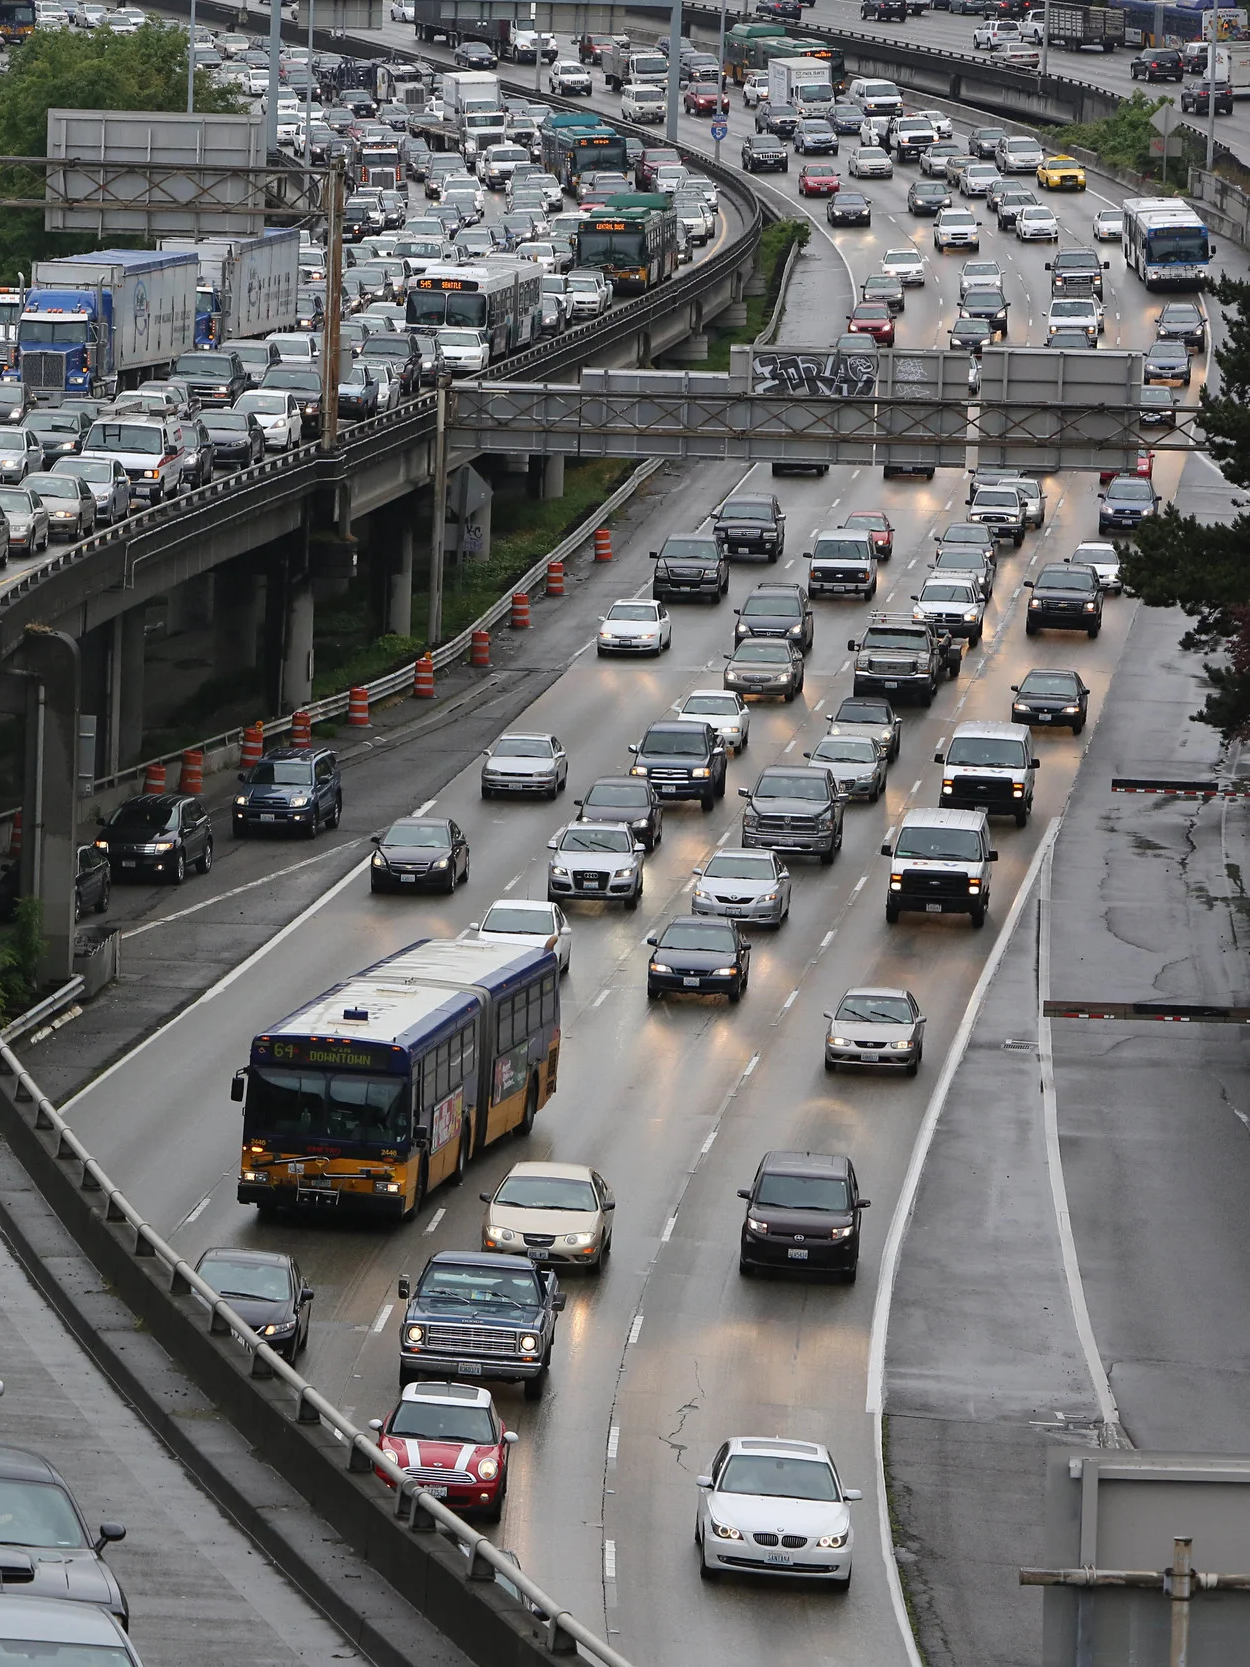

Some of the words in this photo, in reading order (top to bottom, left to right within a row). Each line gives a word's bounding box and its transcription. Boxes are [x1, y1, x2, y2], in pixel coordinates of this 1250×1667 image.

[715, 127, 723, 138] 5
[420, 280, 432, 289] 545
[441, 281, 462, 290] SEATTLE
[274, 1043, 294, 1059] 64
[309, 1050, 371, 1065] DOWNTOWN
